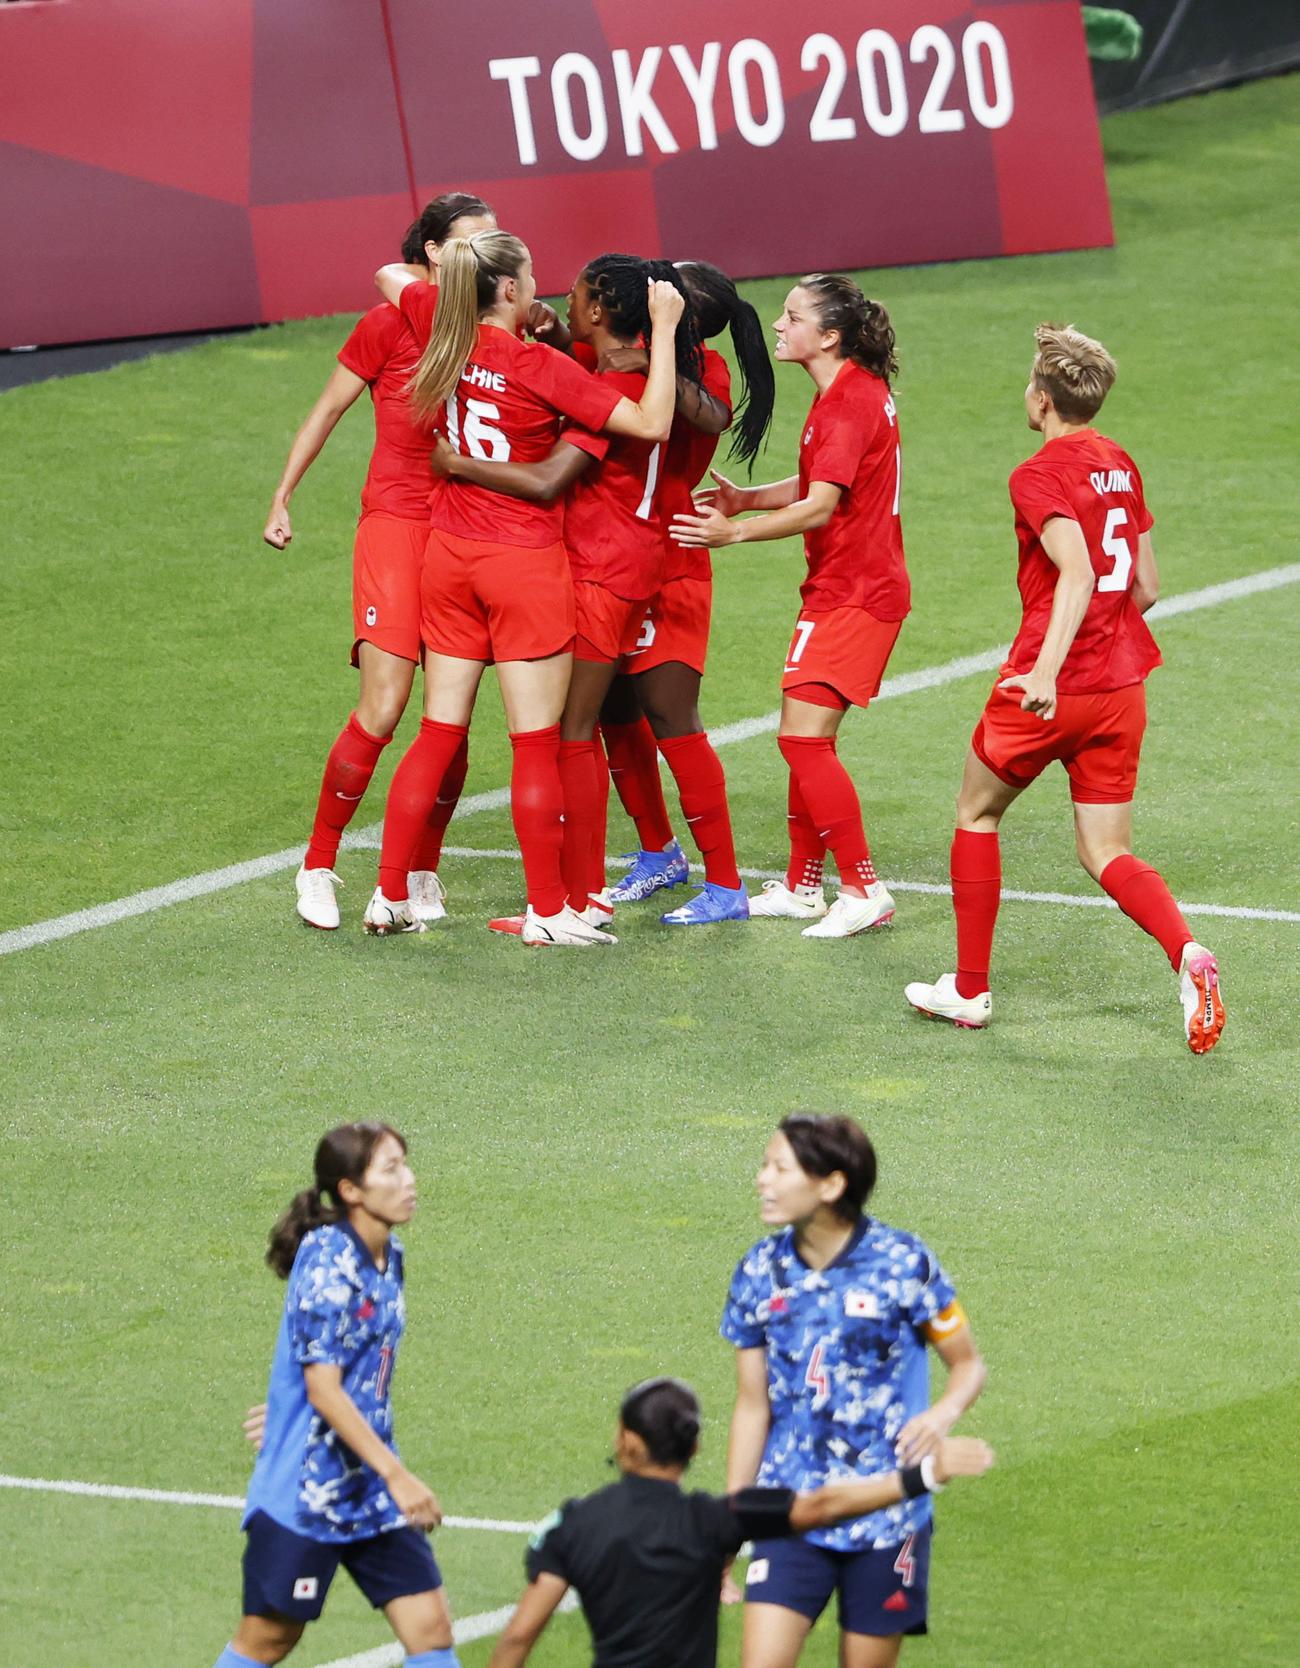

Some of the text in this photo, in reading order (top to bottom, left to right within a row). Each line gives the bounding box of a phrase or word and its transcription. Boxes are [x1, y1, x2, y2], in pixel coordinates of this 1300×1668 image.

[488, 20, 1015, 166] TOKYO 2020
[446, 397, 512, 463] 16
[1097, 507, 1132, 592] 5
[805, 1343, 831, 1398] 4
[893, 1535, 916, 1588] 4
